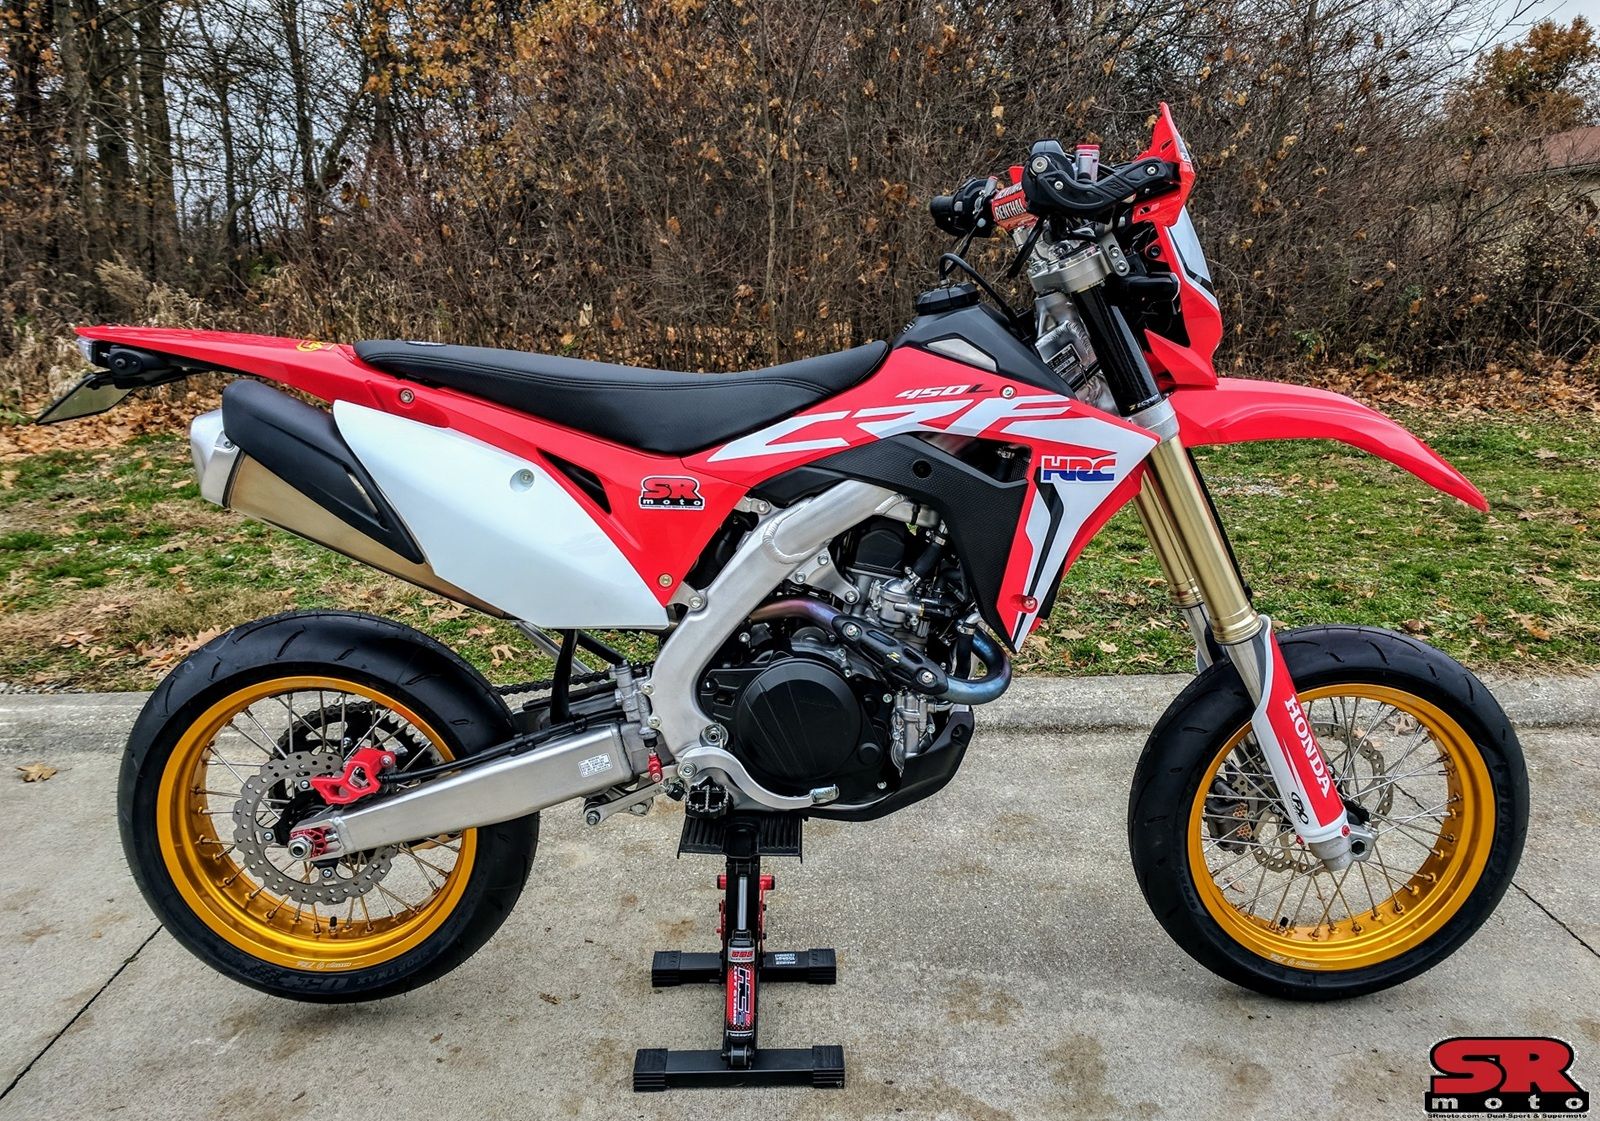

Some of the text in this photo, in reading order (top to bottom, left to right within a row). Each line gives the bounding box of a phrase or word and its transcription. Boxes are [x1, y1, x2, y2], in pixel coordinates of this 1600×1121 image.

[994, 198, 1026, 220] RENTHAL
[896, 383, 996, 400] 450L
[707, 395, 1071, 462] CRF
[1040, 455, 1116, 482] HRC
[642, 476, 701, 499] SR
[1285, 694, 1332, 798] HONDA
